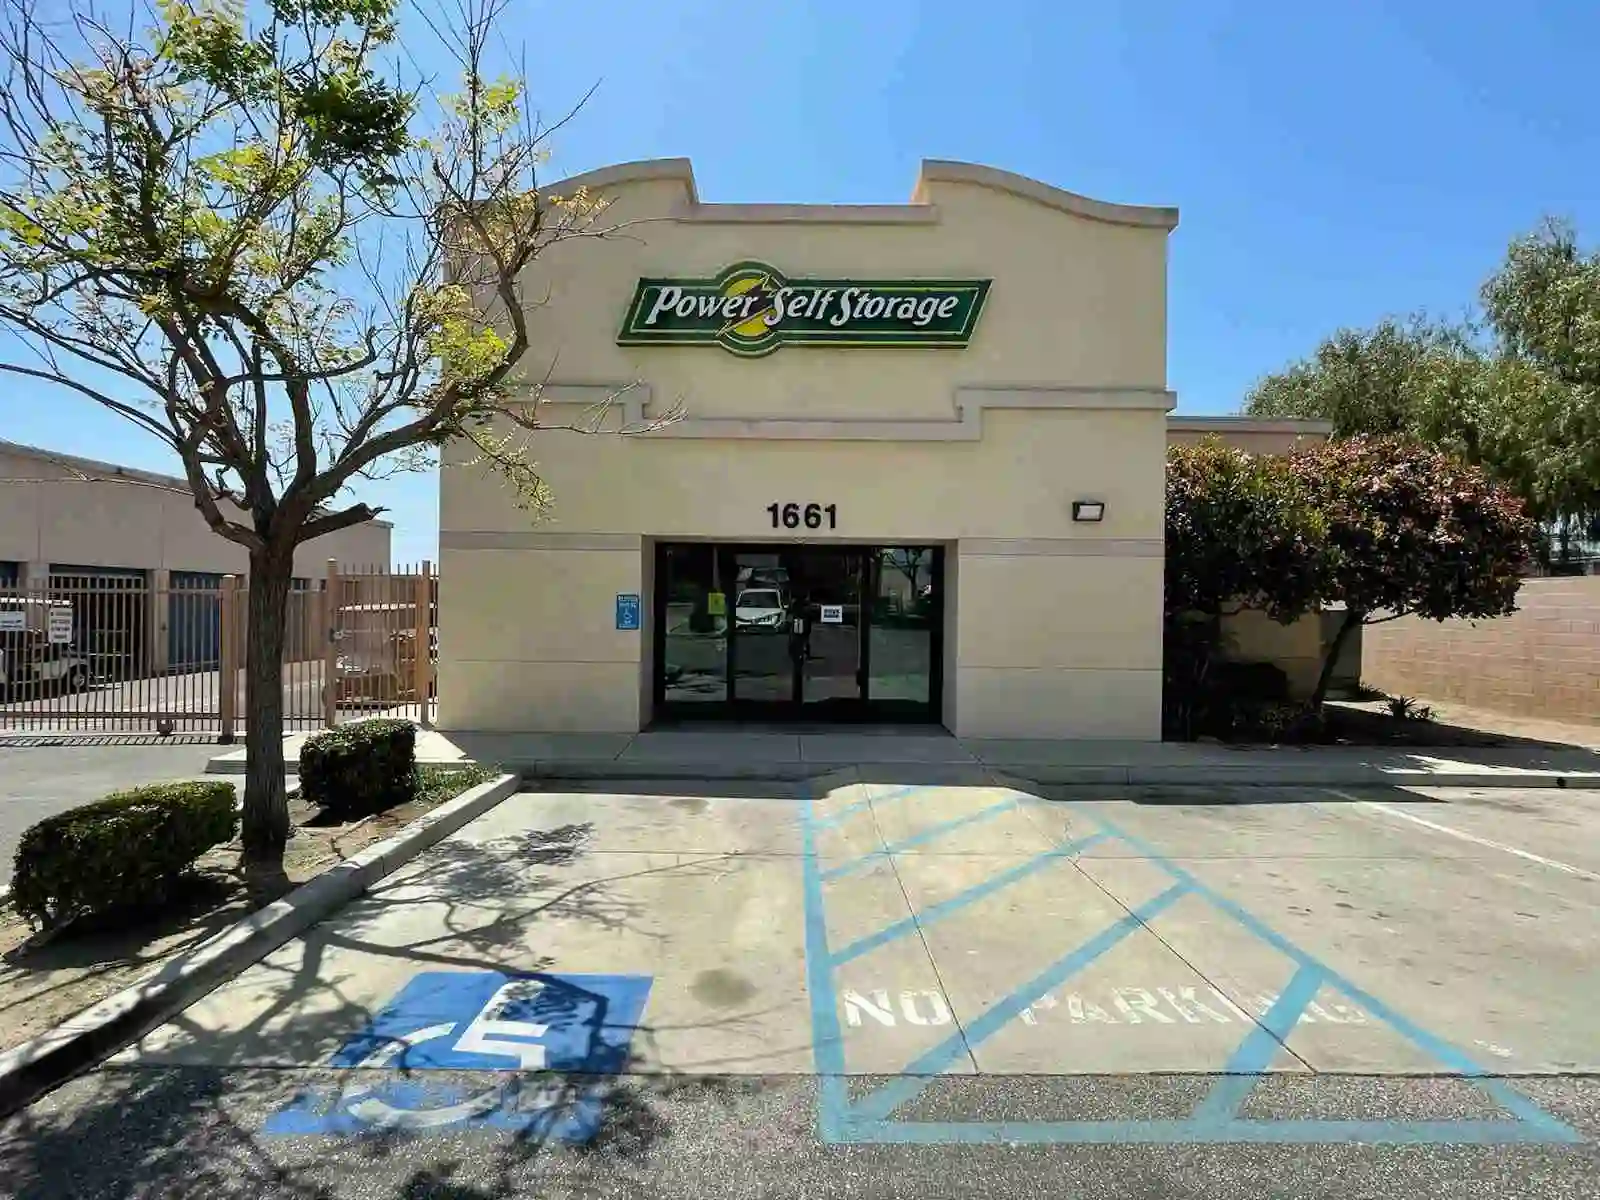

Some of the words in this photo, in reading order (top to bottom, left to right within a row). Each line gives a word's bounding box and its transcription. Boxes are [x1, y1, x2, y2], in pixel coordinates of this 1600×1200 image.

[646, 287, 758, 325] Power
[765, 286, 834, 326] Self
[830, 287, 959, 326] Storage
[767, 503, 837, 529] 1661
[843, 987, 952, 1027] NO
